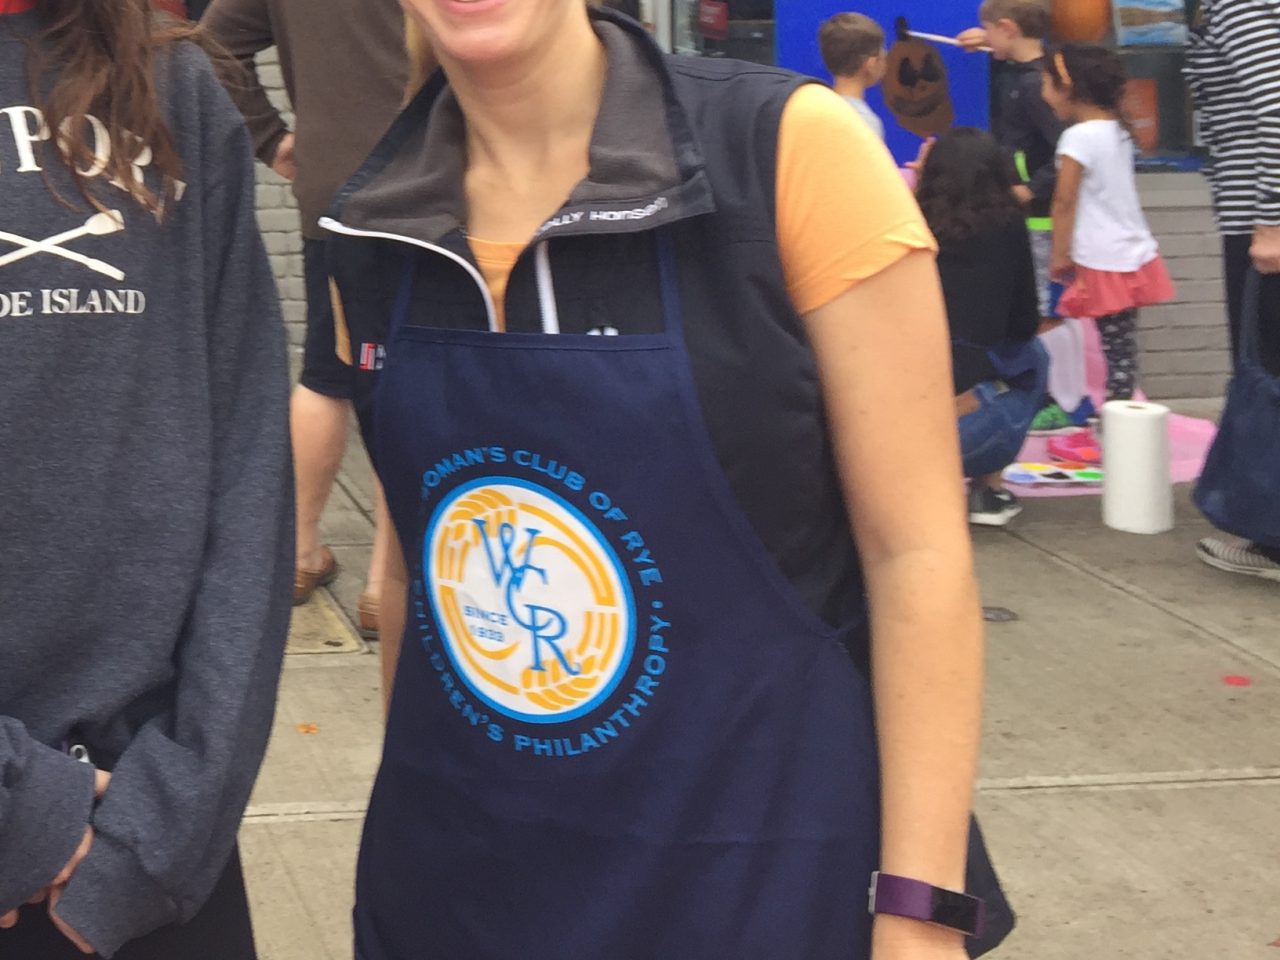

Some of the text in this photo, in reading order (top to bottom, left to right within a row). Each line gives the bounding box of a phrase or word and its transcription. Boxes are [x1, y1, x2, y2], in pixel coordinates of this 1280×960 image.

[41, 288, 146, 315] ISLAND
[420, 446, 664, 587] OMAN'S CLUB OF RYE
[464, 605, 509, 626] SINCE
[513, 614, 673, 758] PHILANTHROPY
